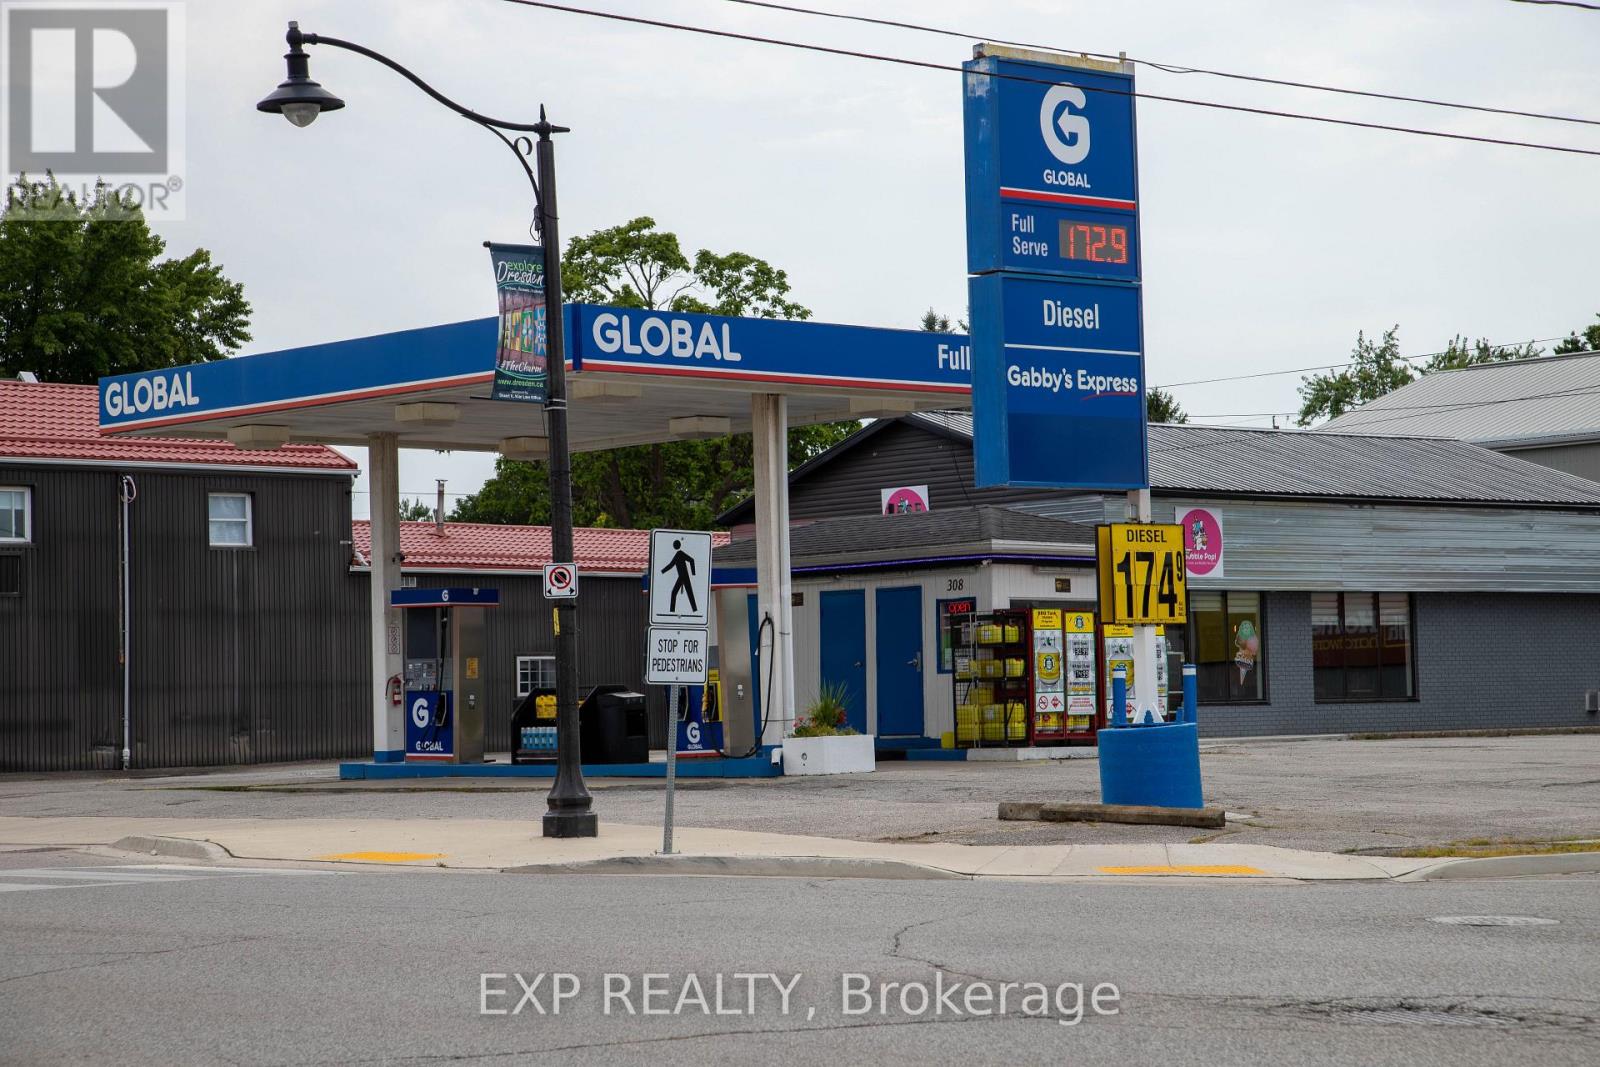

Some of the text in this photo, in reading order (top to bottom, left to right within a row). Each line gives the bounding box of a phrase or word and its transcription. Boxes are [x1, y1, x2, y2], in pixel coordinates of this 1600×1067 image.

[1043, 169, 1091, 188] GLOBAL
[1011, 213, 1035, 233] Full
[1012, 236, 1049, 257] Serve
[1069, 224, 1128, 264] 172.9
[497, 261, 545, 287] Dresden
[507, 259, 543, 274] explore
[1043, 299, 1100, 330] Diesel
[592, 313, 971, 371] GLOBAL Full
[1007, 365, 1138, 395] Gabby's Express
[105, 371, 199, 417] GLOBAL
[1126, 529, 1167, 543] DIESEL
[947, 579, 964, 592] 308
[658, 638, 699, 654] STOP FOR
[652, 658, 703, 673] PEDESTRIANS
